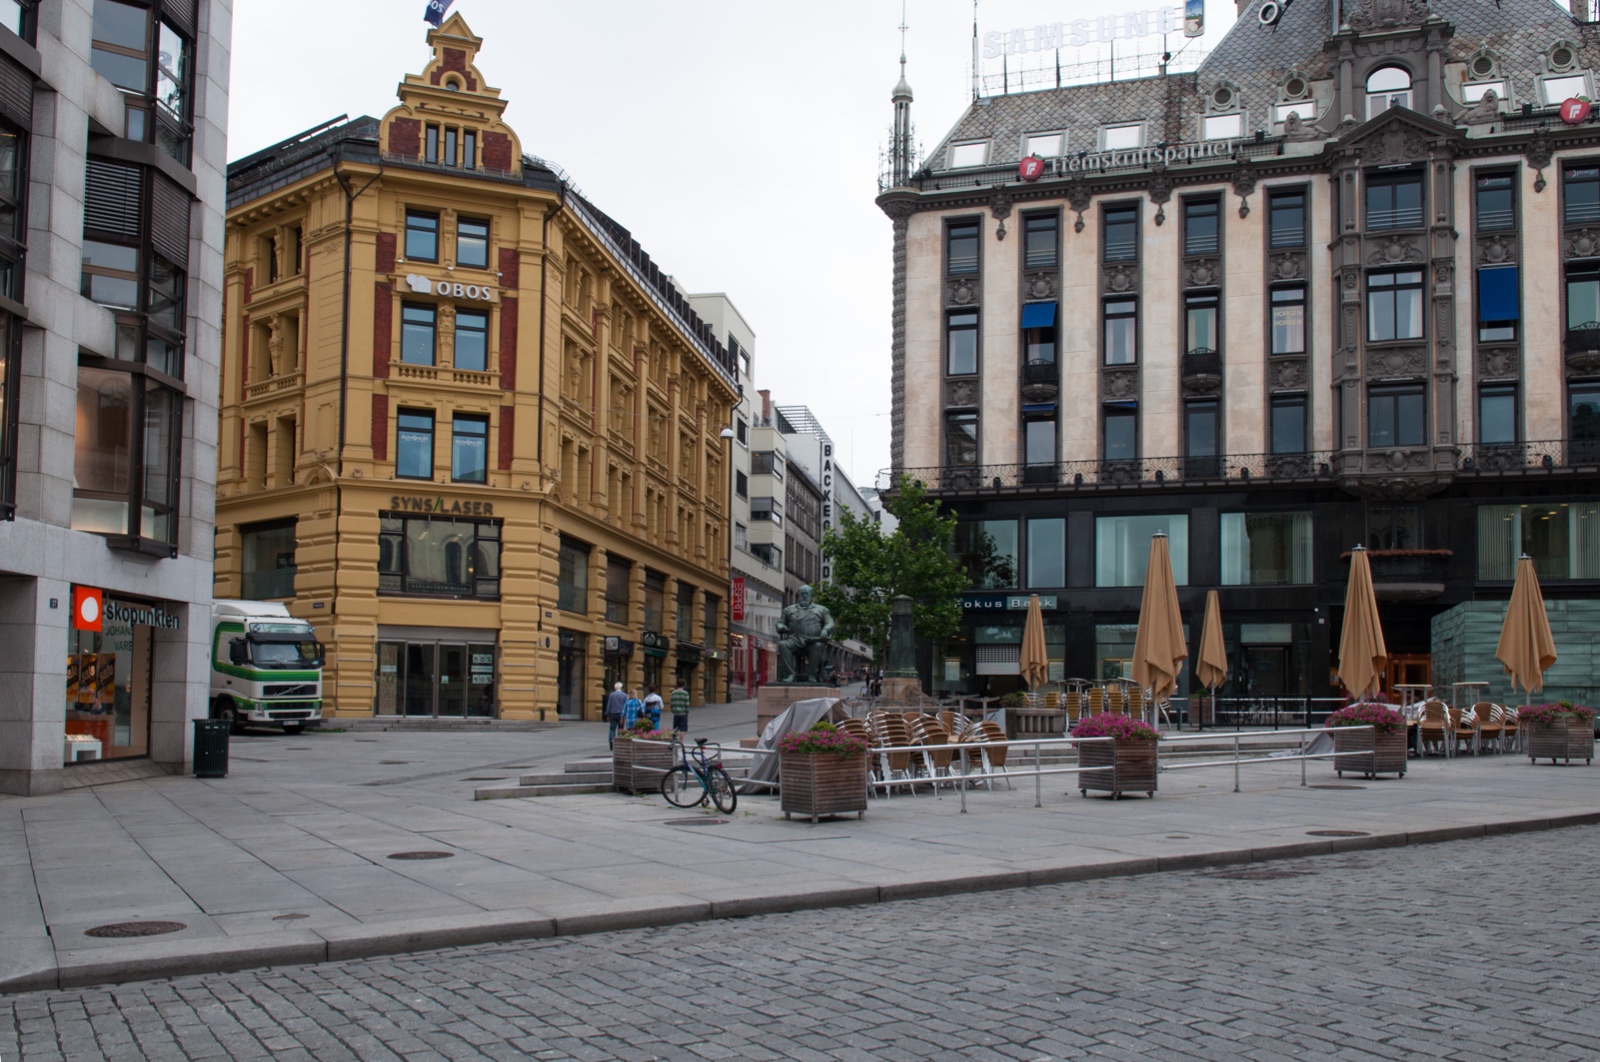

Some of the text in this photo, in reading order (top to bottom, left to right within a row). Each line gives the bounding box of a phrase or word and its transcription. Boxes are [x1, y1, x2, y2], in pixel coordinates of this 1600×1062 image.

[983, 5, 1176, 60] SAMSUNG
[1052, 139, 1234, 173] Fremskrittspartiet
[437, 281, 491, 300] OBOS
[105, 601, 180, 629] skopunkten
[733, 582, 744, 615] ESPRIT
